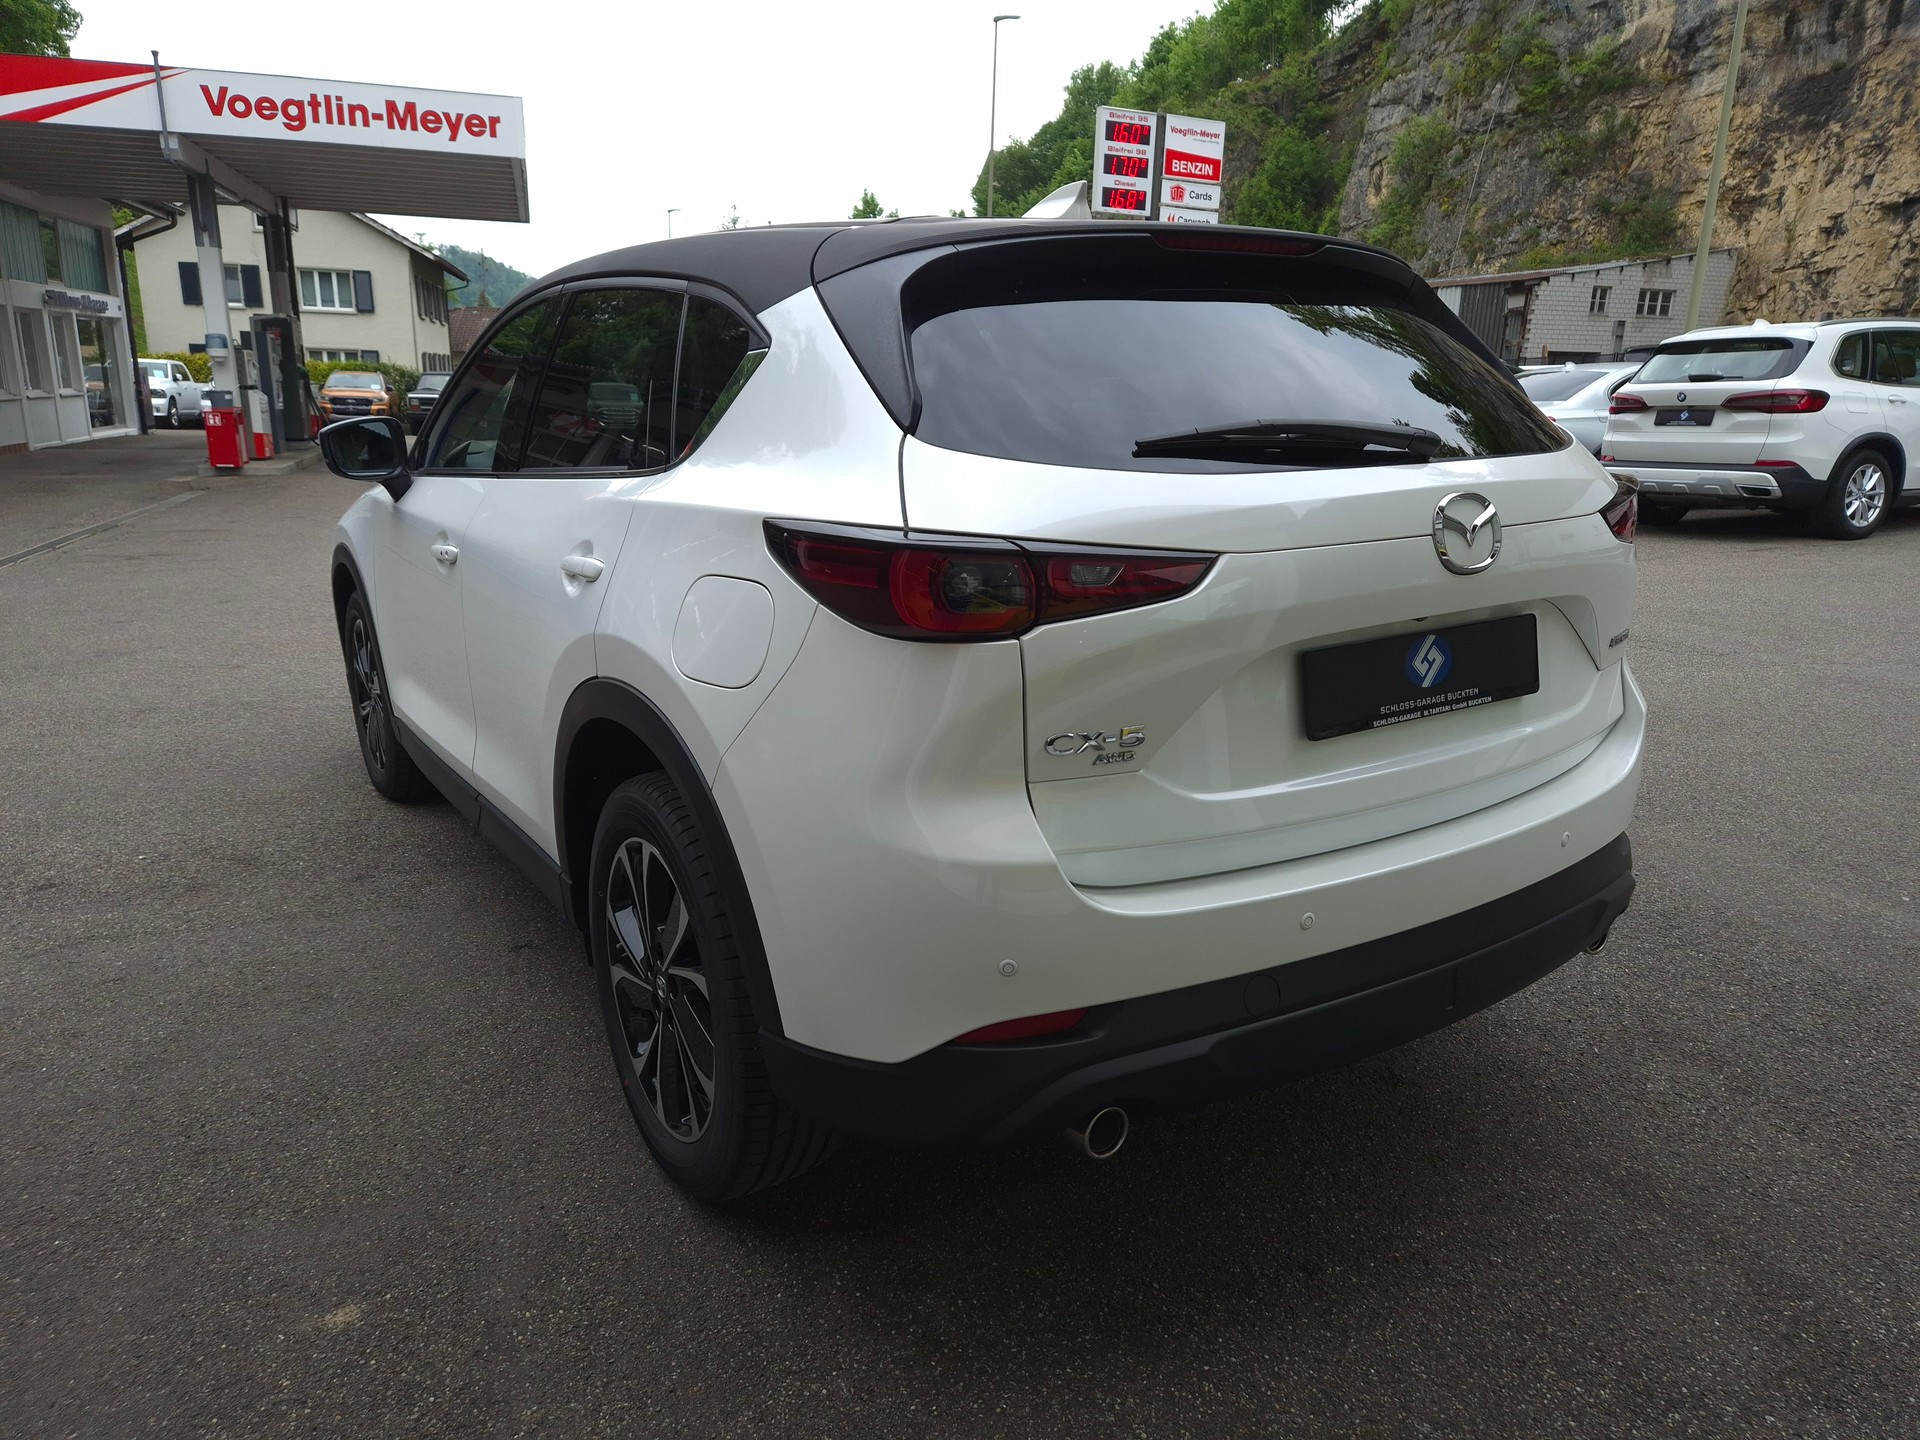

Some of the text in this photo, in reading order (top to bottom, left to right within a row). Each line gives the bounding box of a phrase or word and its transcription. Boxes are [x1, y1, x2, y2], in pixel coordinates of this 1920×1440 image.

[199, 84, 501, 142] Voegtlin-Meyer
[1109, 111, 1136, 121] Bleifrei
[1170, 125, 1221, 140] Voegtlin-Meyer
[1107, 145, 1147, 156] Bleifrei 98
[1172, 159, 1213, 176] BENZIN
[1114, 179, 1137, 188] Diesel
[1189, 190, 1213, 202] Cards
[1447, 687, 1479, 701] BUCKTEN
[1468, 695, 1492, 707] BUCKTEN
[1044, 724, 1146, 757] CX-5
[1091, 750, 1137, 766] AWD
